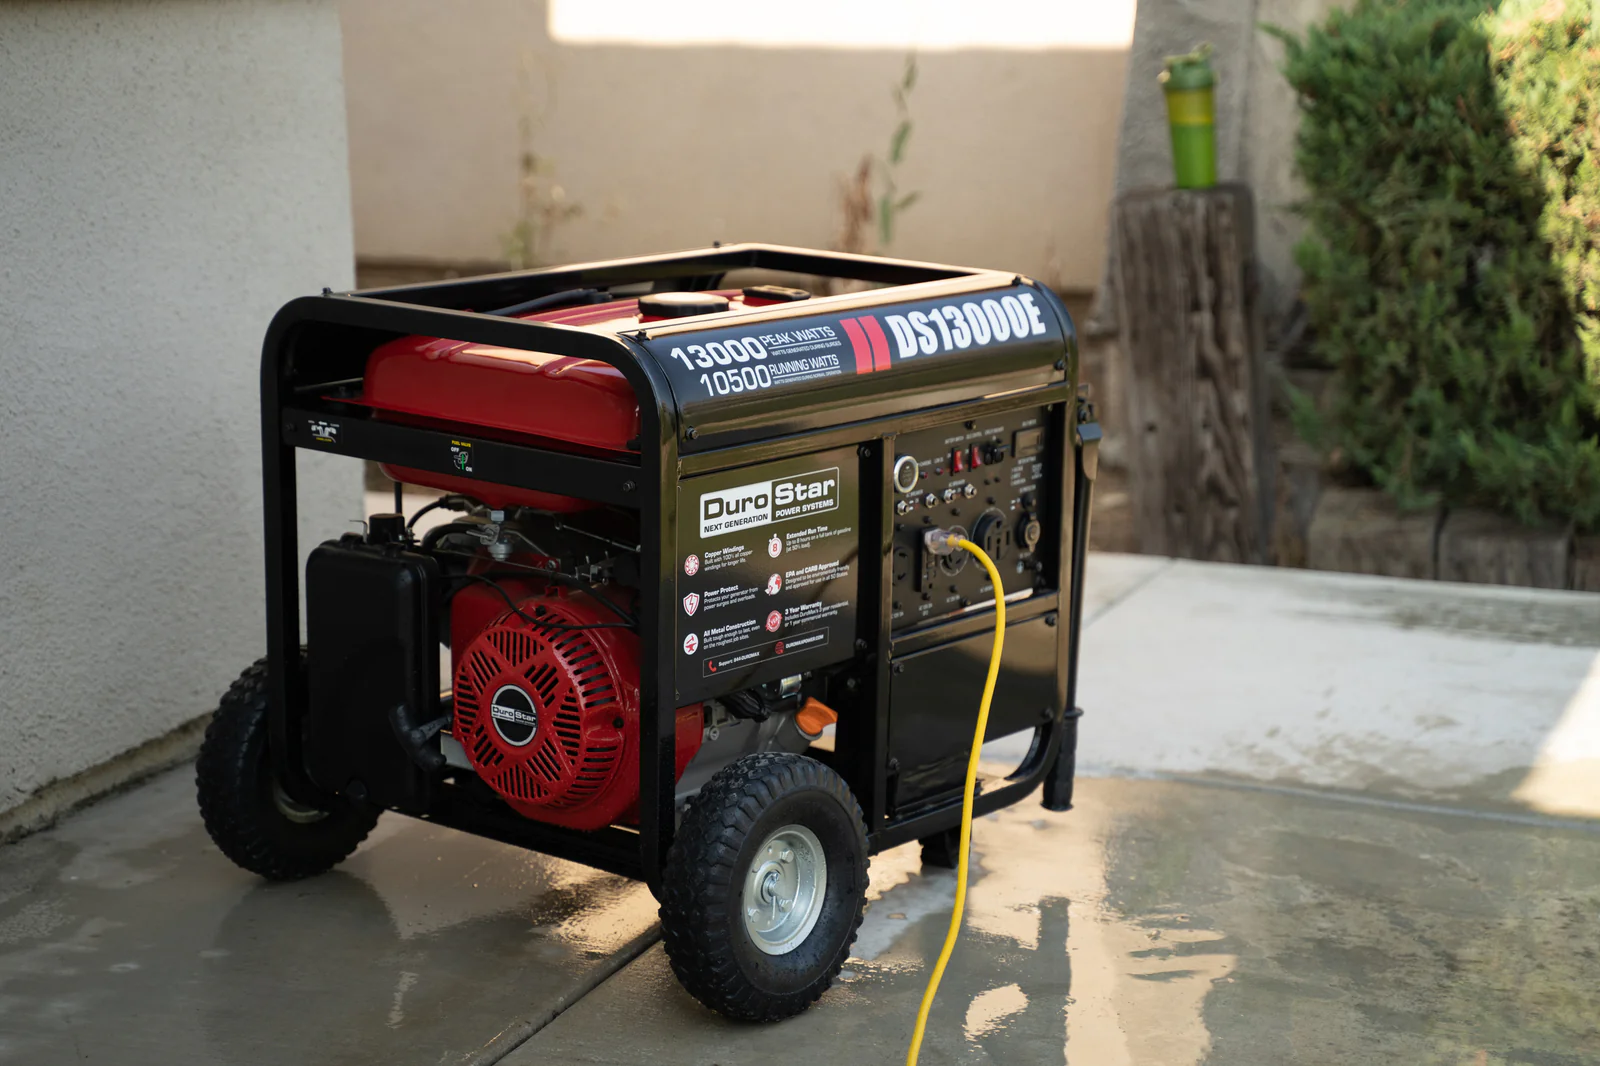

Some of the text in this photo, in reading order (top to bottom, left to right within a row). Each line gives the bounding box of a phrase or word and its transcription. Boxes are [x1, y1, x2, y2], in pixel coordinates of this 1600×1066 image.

[885, 292, 1046, 358] DS13000E
[671, 326, 835, 370] 13000 PEAK WATTS
[786, 345, 809, 353] GENERATED
[700, 354, 839, 396] 10500 RUNNING WATTS
[704, 479, 835, 520] Duro Star
[776, 499, 834, 517] POWER SYSTEMS
[704, 513, 768, 533] NEXT GENERATION
[787, 530, 807, 539] Extended
[722, 545, 744, 554] Windings
[805, 565, 818, 573] CARB
[819, 560, 839, 570] Approved
[720, 585, 738, 593] Protect
[800, 601, 822, 611] Warranty
[711, 626, 725, 635] Metal
[726, 620, 756, 631] Construction
[493, 706, 513, 716] Duro
[515, 711, 536, 721] Star
